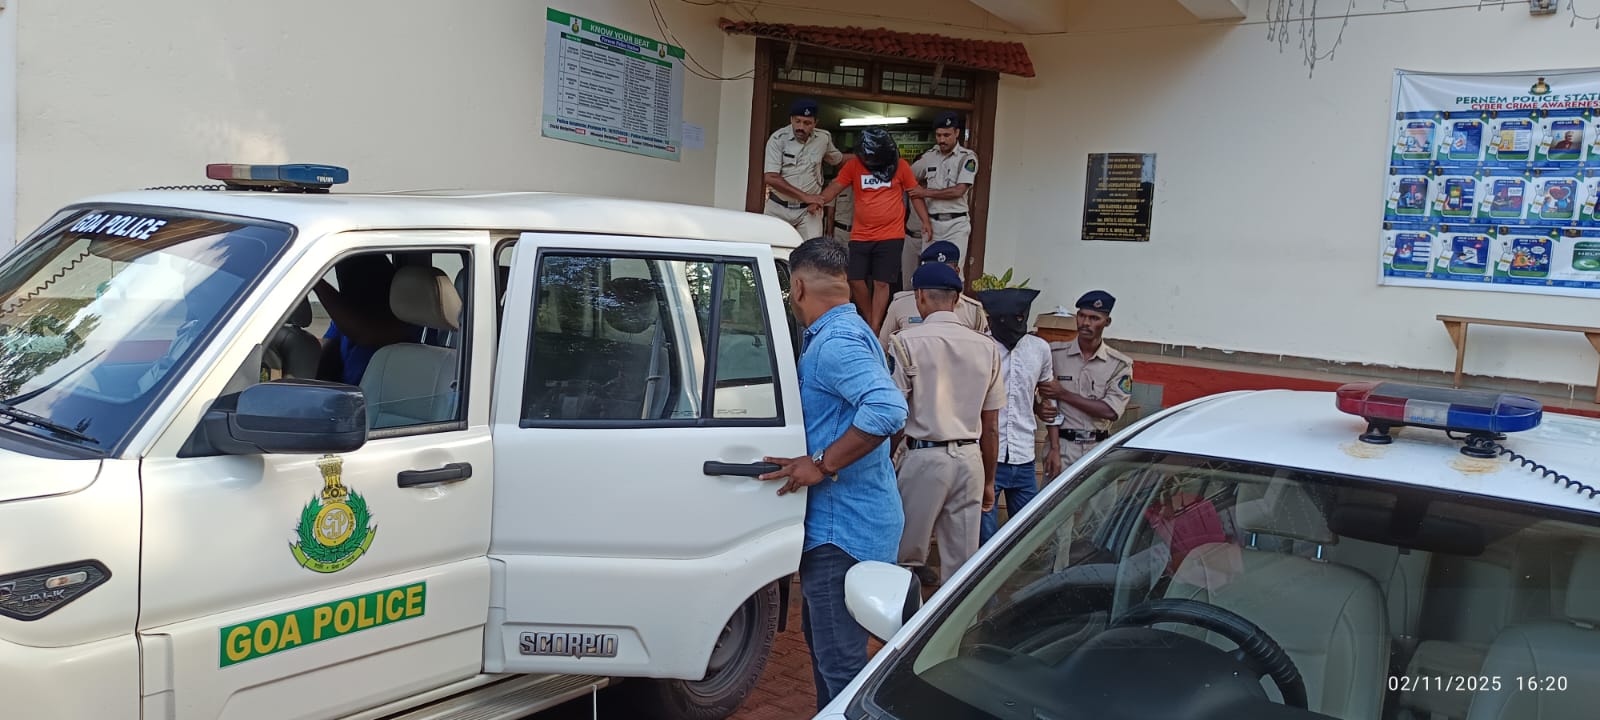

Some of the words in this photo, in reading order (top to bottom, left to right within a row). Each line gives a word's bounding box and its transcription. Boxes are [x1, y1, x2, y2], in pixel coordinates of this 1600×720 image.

[590, 24, 613, 36] KNOW
[614, 31, 633, 43] YOUR
[634, 37, 650, 48] BEAT
[1456, 96, 1507, 104] PERNEM
[1513, 95, 1559, 103] POLICE
[1506, 102, 1538, 110] CRIME
[70, 214, 110, 233] GOA
[96, 215, 167, 240] POLICE
[226, 614, 301, 661] GOA
[313, 585, 423, 640] POLICE
[519, 631, 619, 659] SCORPIO
